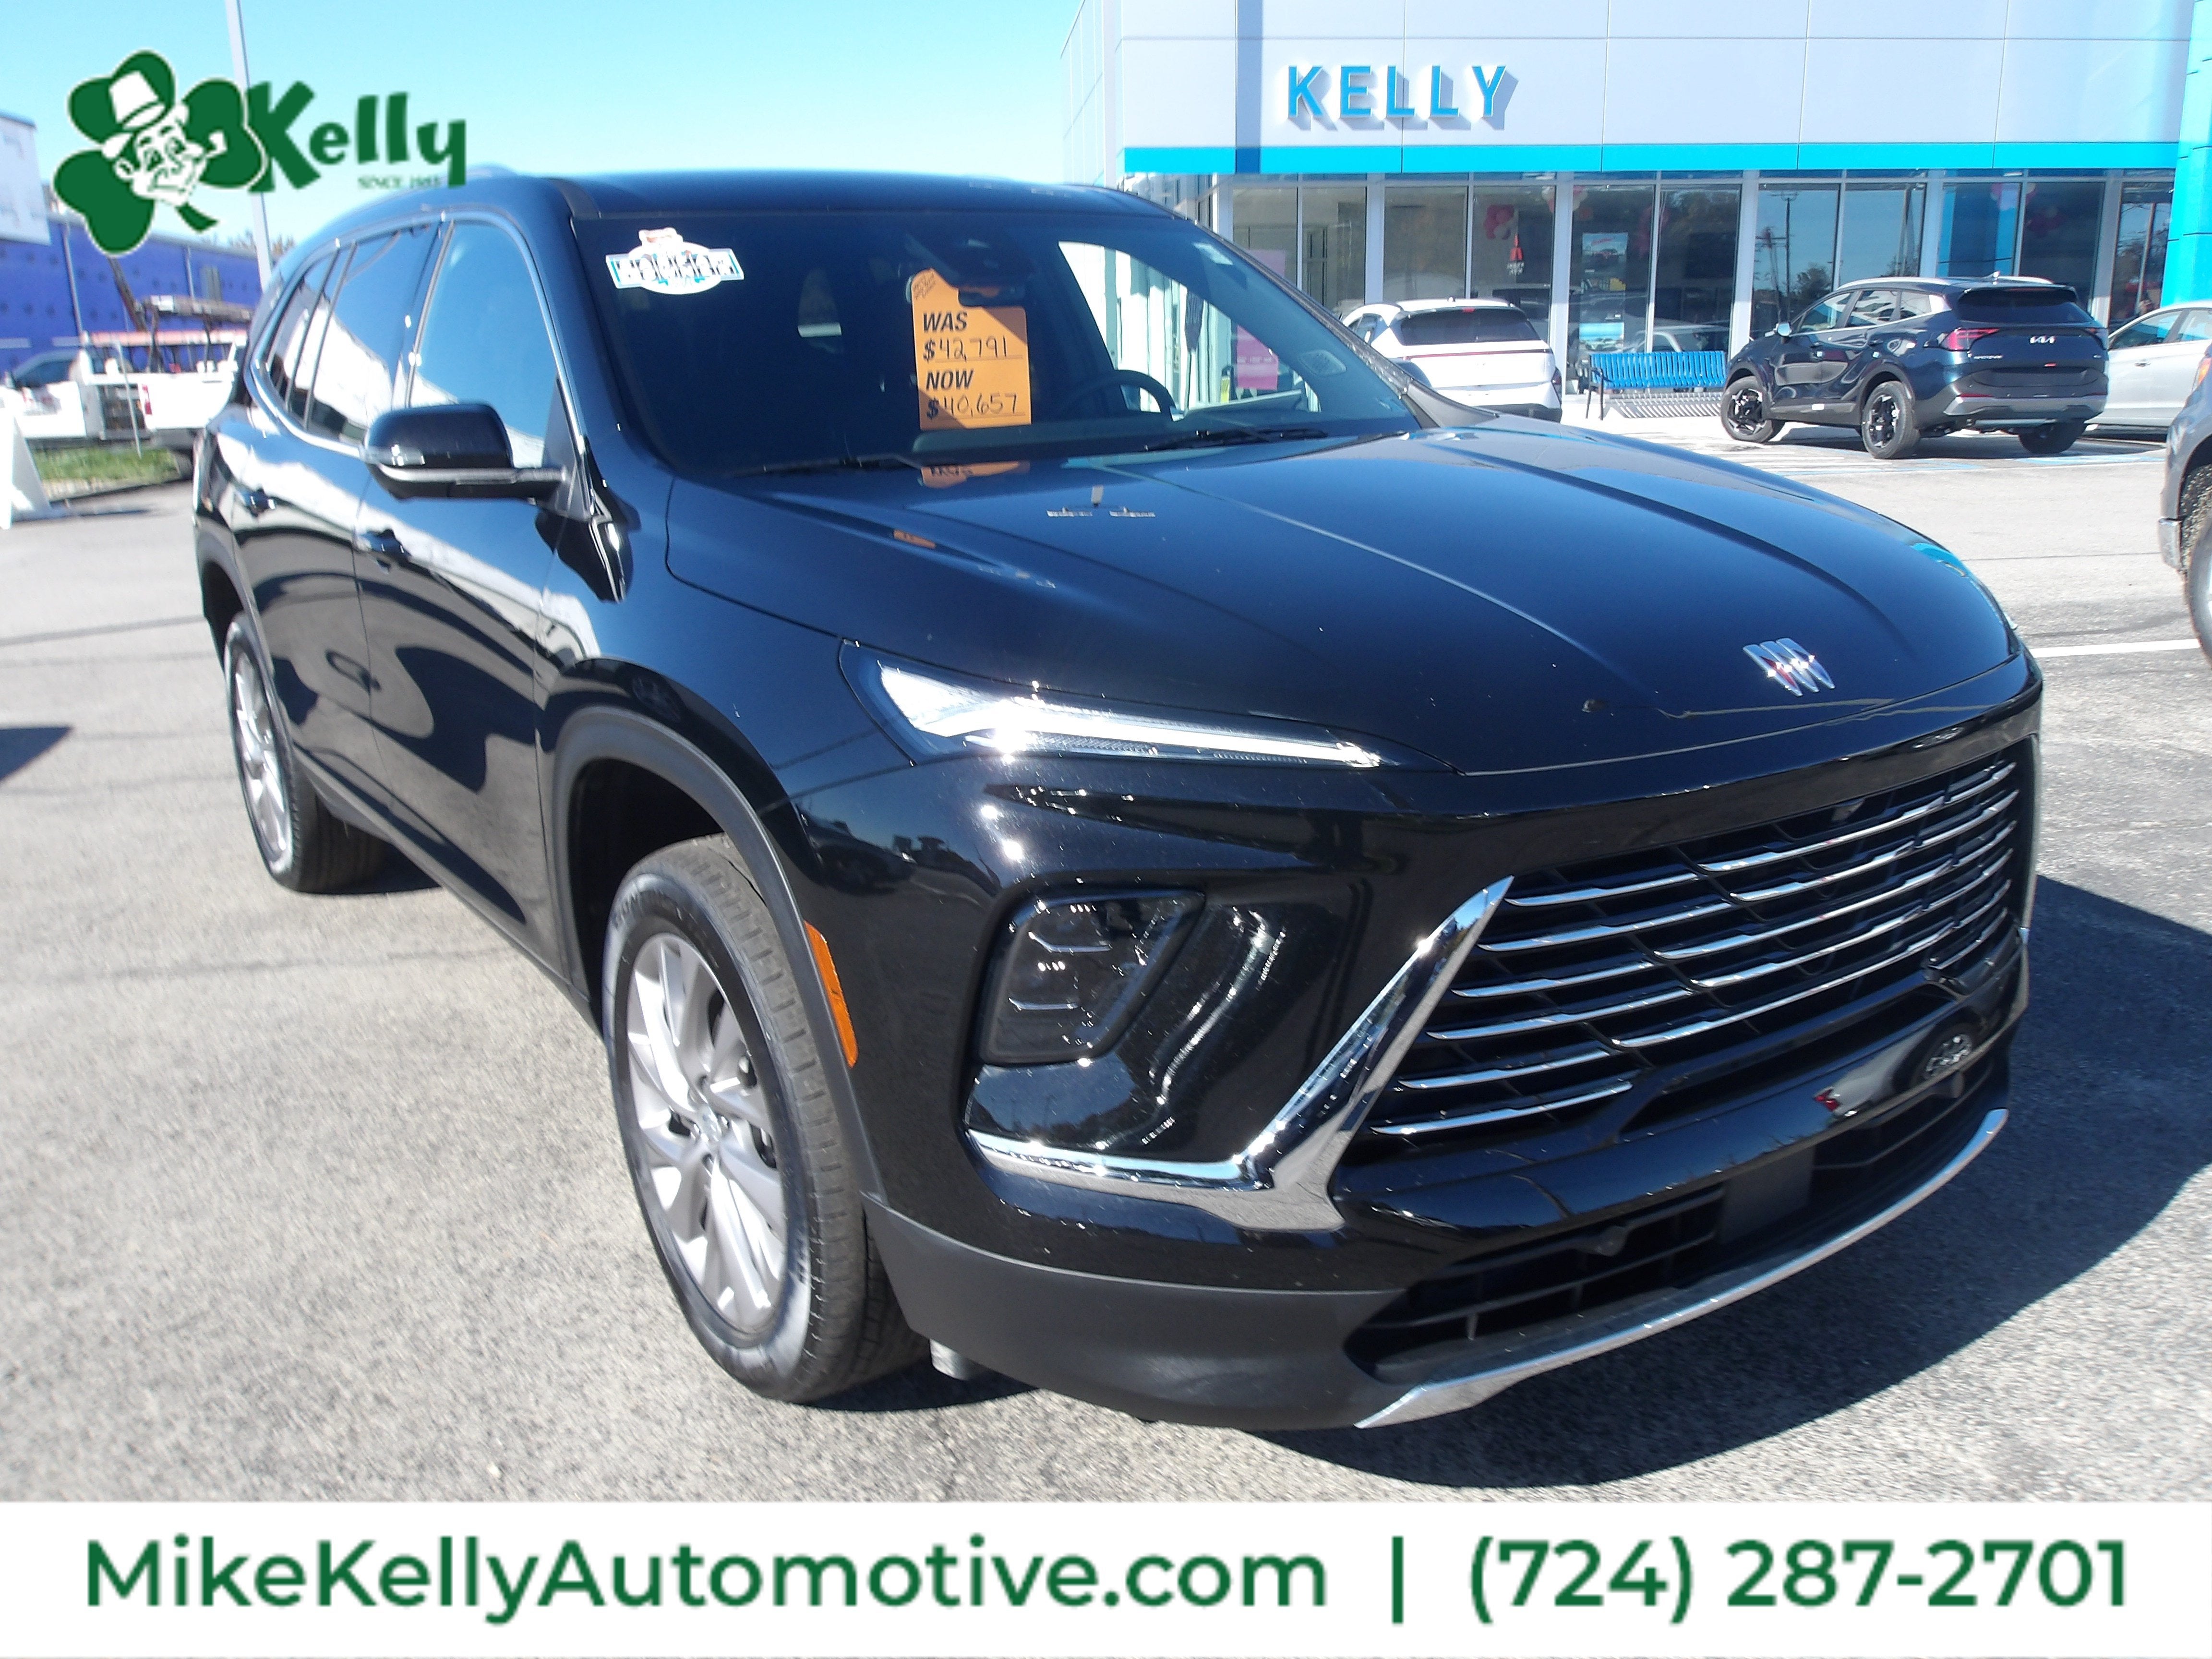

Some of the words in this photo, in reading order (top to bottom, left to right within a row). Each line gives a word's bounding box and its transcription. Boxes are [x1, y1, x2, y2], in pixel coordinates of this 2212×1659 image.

[1288, 65, 1506, 117] KELLY
[923, 312, 968, 332] WAS
[923, 336, 1007, 363] $42,791
[926, 369, 974, 391] NOW
[926, 393, 1017, 420] $40,657
